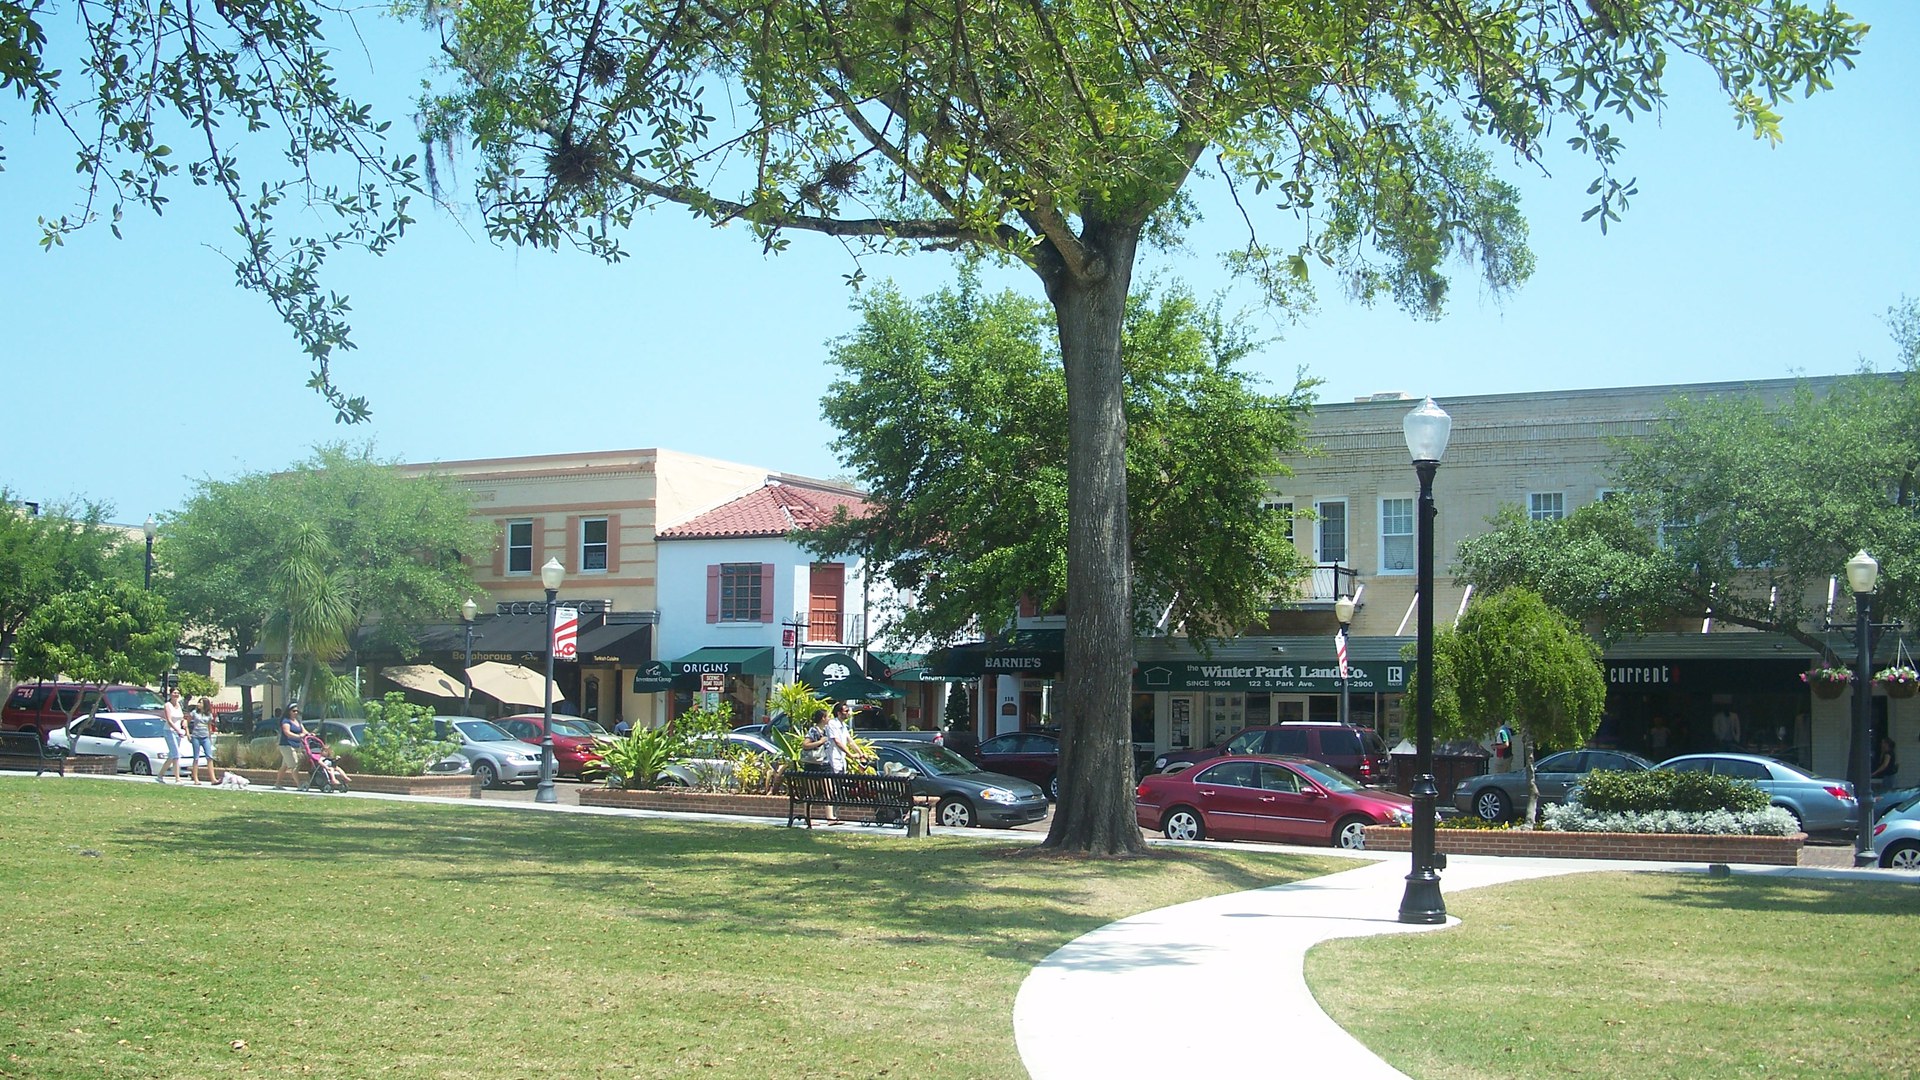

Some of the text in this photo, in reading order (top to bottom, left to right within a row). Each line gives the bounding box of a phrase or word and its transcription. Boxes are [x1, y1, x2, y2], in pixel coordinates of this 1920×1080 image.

[452, 651, 513, 661] Bophorous
[985, 657, 1041, 668] BARNIE'S
[683, 663, 729, 673] ORIGINS
[1200, 665, 1253, 678] Winter
[1255, 665, 1294, 678] Park
[1300, 666, 1340, 678] Land
[1347, 667, 1367, 678] Co.
